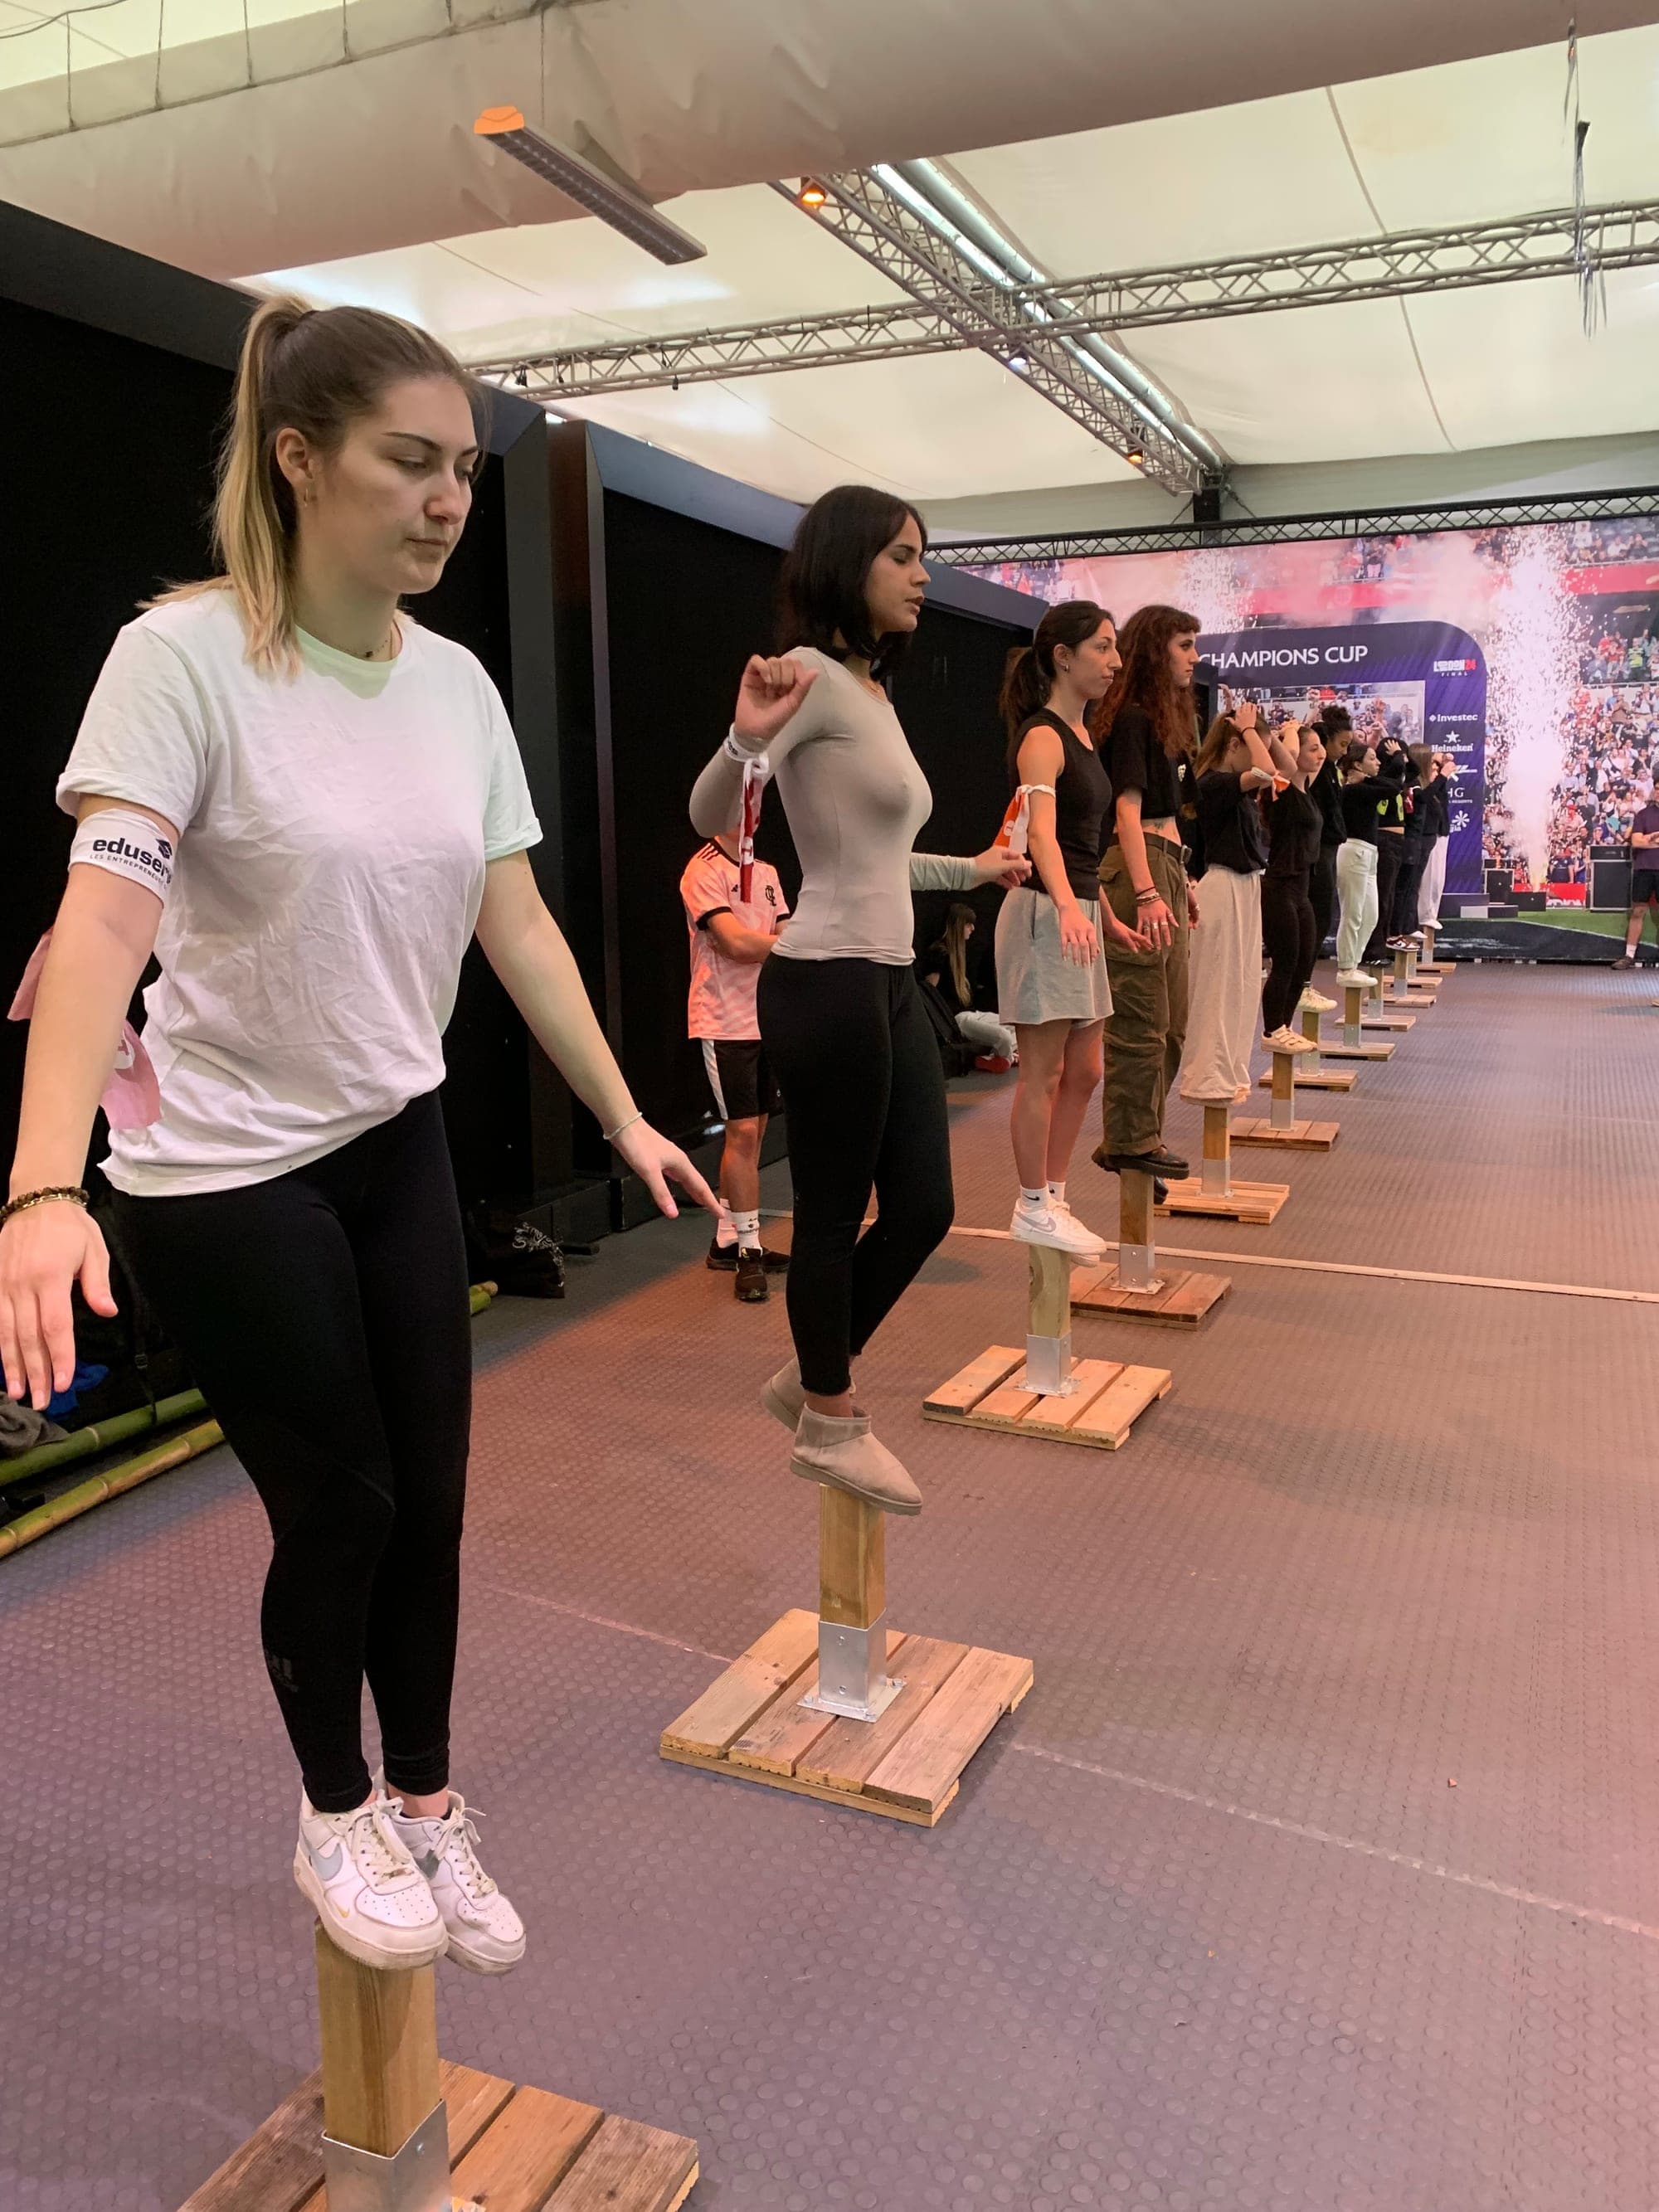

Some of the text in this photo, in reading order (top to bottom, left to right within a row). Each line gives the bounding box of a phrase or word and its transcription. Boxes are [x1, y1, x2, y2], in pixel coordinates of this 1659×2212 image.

[1199, 645, 1369, 668] CHAMPIONS CUP
[1431, 743, 1473, 752] Heineken
[1447, 787, 1465, 798] HG
